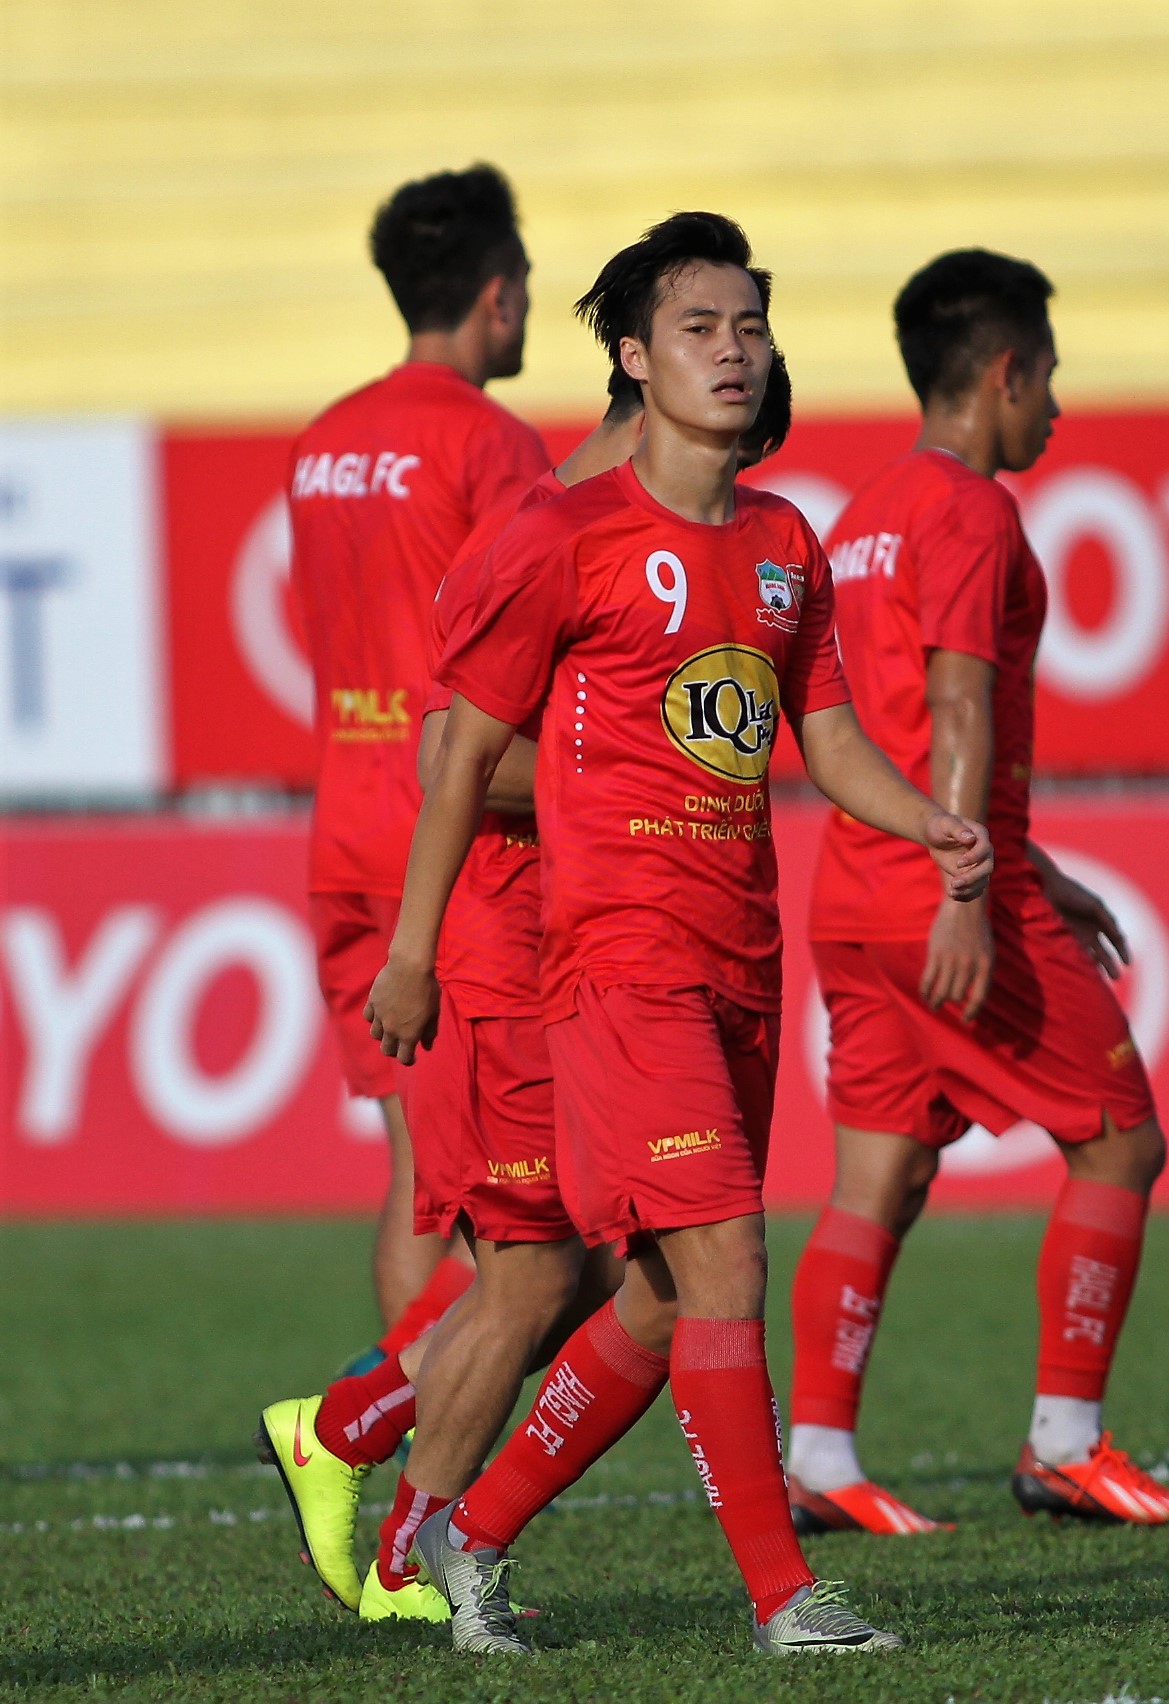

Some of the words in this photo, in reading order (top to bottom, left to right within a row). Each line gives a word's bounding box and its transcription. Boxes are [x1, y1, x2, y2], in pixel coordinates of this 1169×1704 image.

[370, 450, 421, 499] FC
[645, 550, 689, 635] 9
[680, 677, 757, 757] IQ
[629, 815, 685, 837] PHÁT
[647, 1128, 721, 1155] VPMILK
[539, 1360, 596, 1429] HAGL
[525, 1409, 565, 1457] FC
